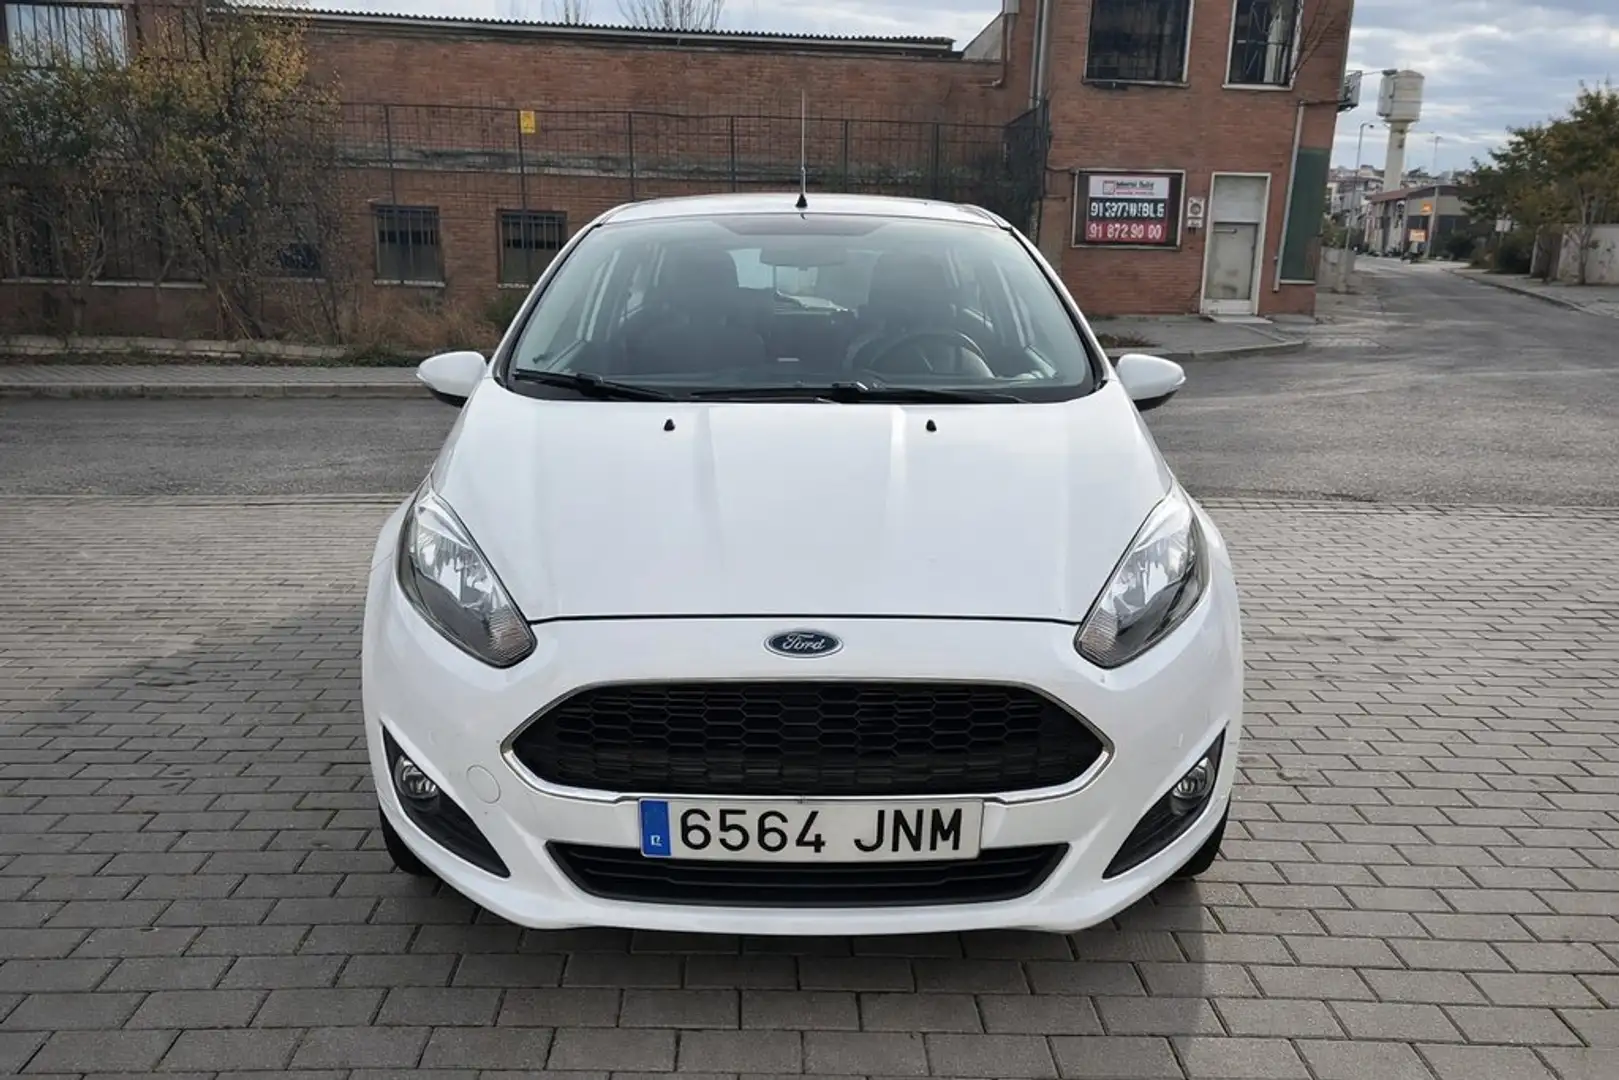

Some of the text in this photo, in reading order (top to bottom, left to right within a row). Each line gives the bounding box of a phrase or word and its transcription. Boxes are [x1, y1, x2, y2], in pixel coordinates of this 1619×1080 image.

[782, 632, 826, 651] Ford
[680, 807, 962, 853] 6564 JNM
